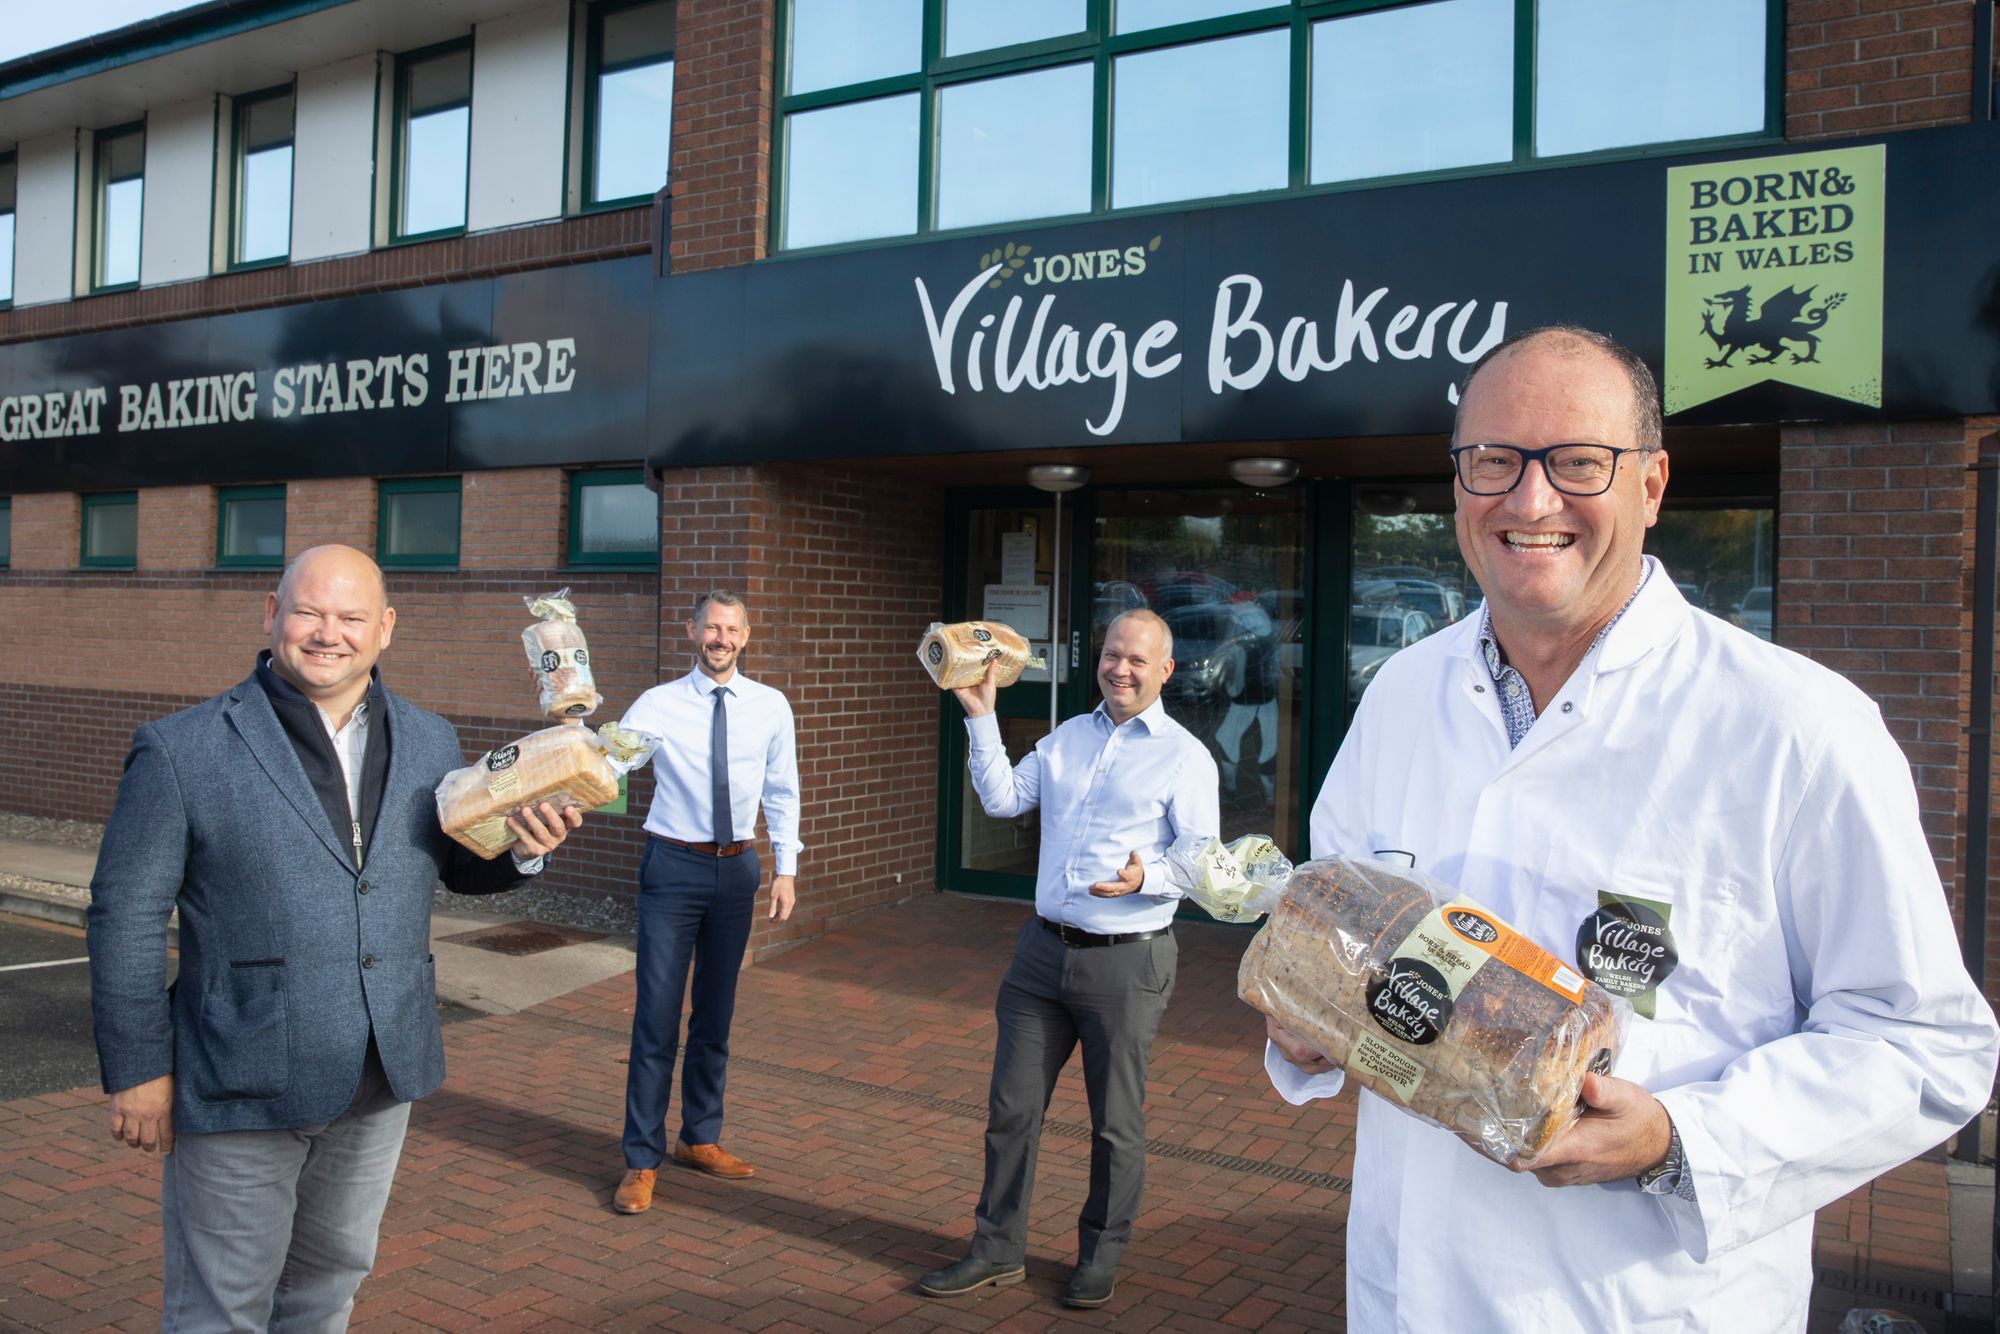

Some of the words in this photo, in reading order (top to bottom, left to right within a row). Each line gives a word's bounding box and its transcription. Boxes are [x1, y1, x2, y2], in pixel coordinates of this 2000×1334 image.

[1689, 203, 1854, 246] BAKED
[1688, 251, 1723, 275] IN
[1735, 240, 1855, 272] WALES
[914, 262, 1182, 436] Village
[1207, 273, 1508, 406] Bakery
[0, 387, 107, 442] GREAT
[117, 370, 258, 432] BAKING
[271, 352, 430, 419] STARTS
[444, 336, 577, 404] HERE
[1418, 932, 1438, 949] BORN
[1445, 951, 1471, 971] BREAD
[1427, 946, 1436, 954] IN
[1435, 950, 1457, 968] WALES
[1596, 915, 1665, 962] Village
[1588, 943, 1656, 984] Bakery
[1608, 973, 1632, 982] WELSH
[1389, 962, 1440, 1021] Village
[1594, 976, 1620, 986] FAMILY
[1619, 980, 1646, 991] BAKERS
[1604, 983, 1622, 991] SINCE
[1374, 988, 1427, 1039] Bakery
[1357, 1048, 1370, 1057] for
[1369, 1055, 1415, 1085] Outstanding
[1360, 1043, 1381, 1060] rising
[1382, 1057, 1417, 1078] naturally
[1360, 1056, 1408, 1088] FLAVOUR
[1365, 1036, 1388, 1053] SLOW
[1388, 1050, 1417, 1072] DOUGH
